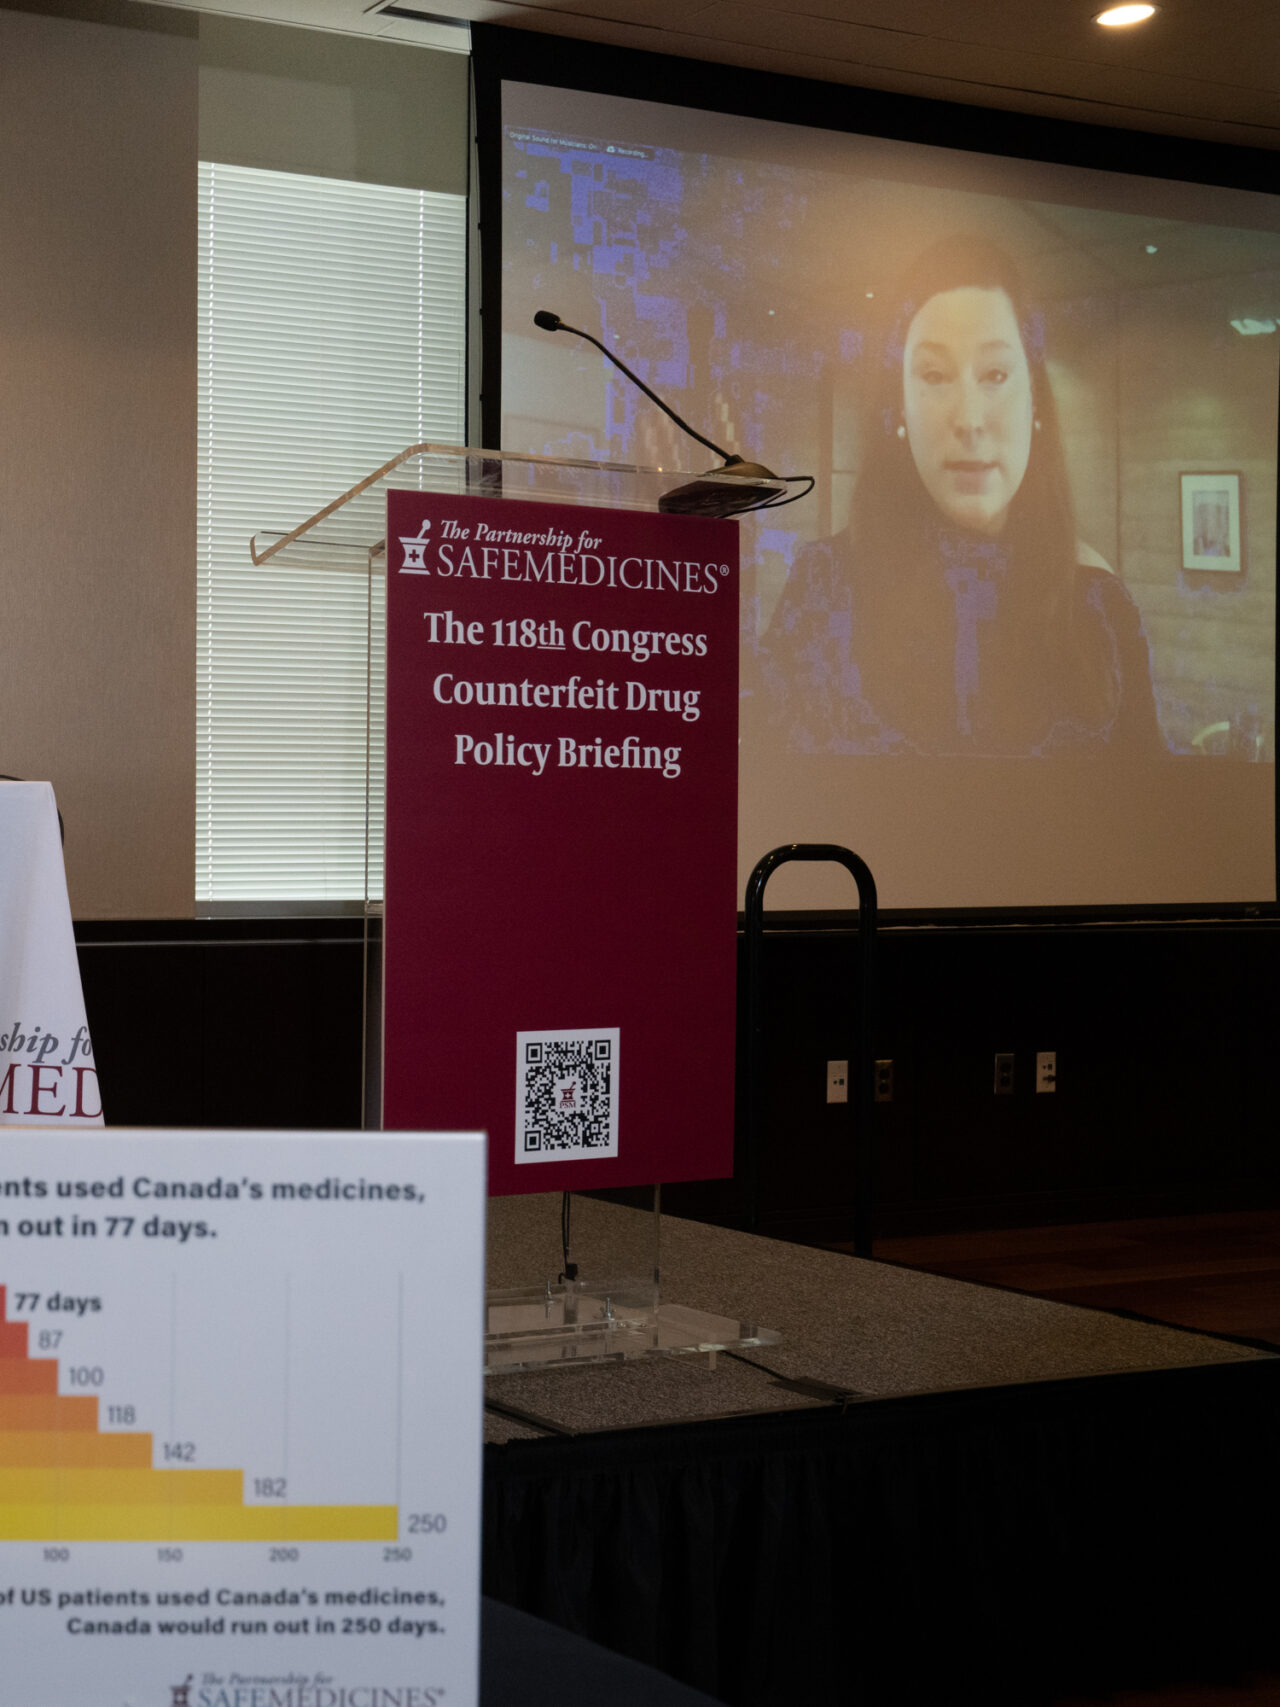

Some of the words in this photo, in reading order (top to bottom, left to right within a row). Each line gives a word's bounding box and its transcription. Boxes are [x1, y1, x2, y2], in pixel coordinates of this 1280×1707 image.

[440, 519, 470, 540] The
[474, 523, 573, 553] Partnership
[574, 530, 603, 554] for
[437, 543, 729, 594] SAFEMEDICINES®
[423, 610, 484, 646] The
[491, 618, 566, 650] 118th
[572, 621, 708, 662] Congress
[433, 673, 619, 710] Counterfeit
[625, 681, 701, 722] Drug
[454, 733, 551, 776] Policy
[558, 736, 682, 779] Briefing
[560, 1101, 577, 1109] PSM
[57, 1177, 124, 1199] used
[132, 1176, 263, 1200] Canada's
[271, 1178, 425, 1203] medicines,
[17, 1216, 64, 1237] out
[72, 1216, 97, 1237] in
[105, 1217, 135, 1237] 77
[143, 1215, 217, 1243] days.
[14, 1293, 40, 1312] 77
[47, 1292, 102, 1317] days
[38, 1330, 64, 1350] 87
[69, 1367, 104, 1387] 100
[107, 1405, 136, 1425] 118
[163, 1442, 196, 1463] 142
[253, 1478, 287, 1498] 182
[407, 1514, 447, 1535] 250
[43, 1547, 69, 1563] 100
[157, 1547, 183, 1563] 150
[269, 1547, 300, 1563] 200
[383, 1548, 413, 1564] 250
[21, 1588, 52, 1607] US
[58, 1588, 150, 1612] patients
[156, 1588, 210, 1607] used
[215, 1588, 318, 1608] Canada's
[324, 1588, 446, 1610] medicines,
[67, 1616, 152, 1636] Canada
[158, 1616, 225, 1636] would
[231, 1620, 268, 1636] run
[273, 1618, 311, 1636] out
[316, 1617, 336, 1636] in
[341, 1617, 381, 1636] 250
[387, 1616, 446, 1640] days.
[201, 1672, 224, 1686] The
[228, 1672, 309, 1687] Partnership
[311, 1671, 334, 1689] for
